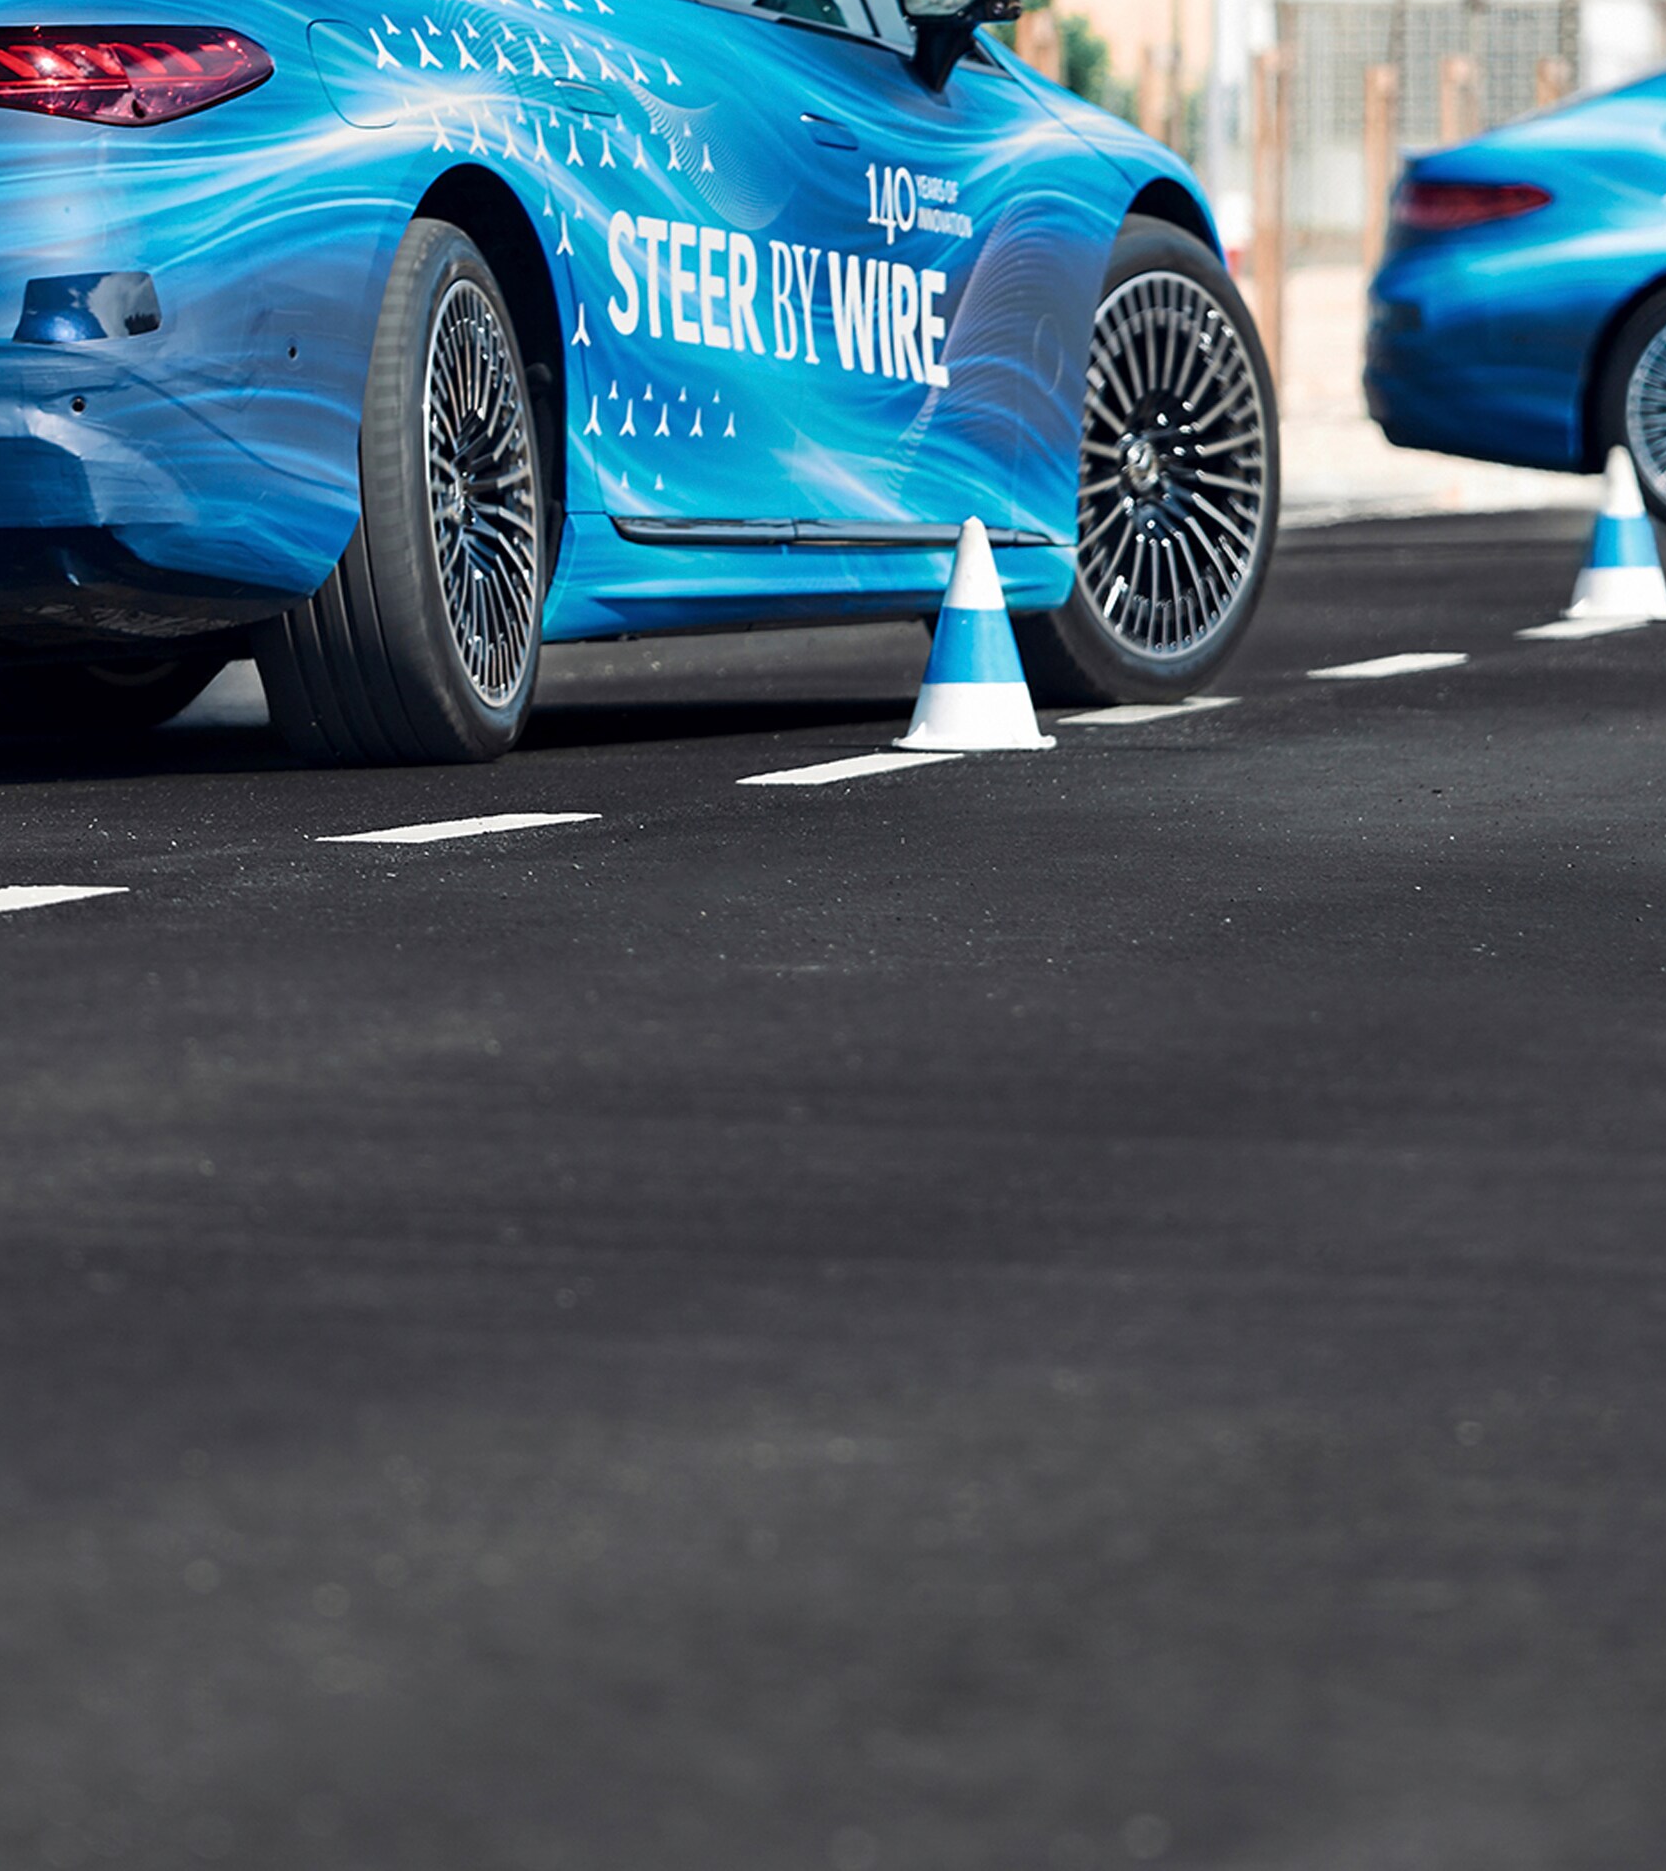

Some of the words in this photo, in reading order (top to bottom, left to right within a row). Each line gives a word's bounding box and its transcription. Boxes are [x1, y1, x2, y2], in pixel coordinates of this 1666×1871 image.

[865, 163, 916, 245] 140
[607, 210, 766, 355] STEER
[768, 240, 821, 365] BY
[827, 250, 950, 389] WIRE
